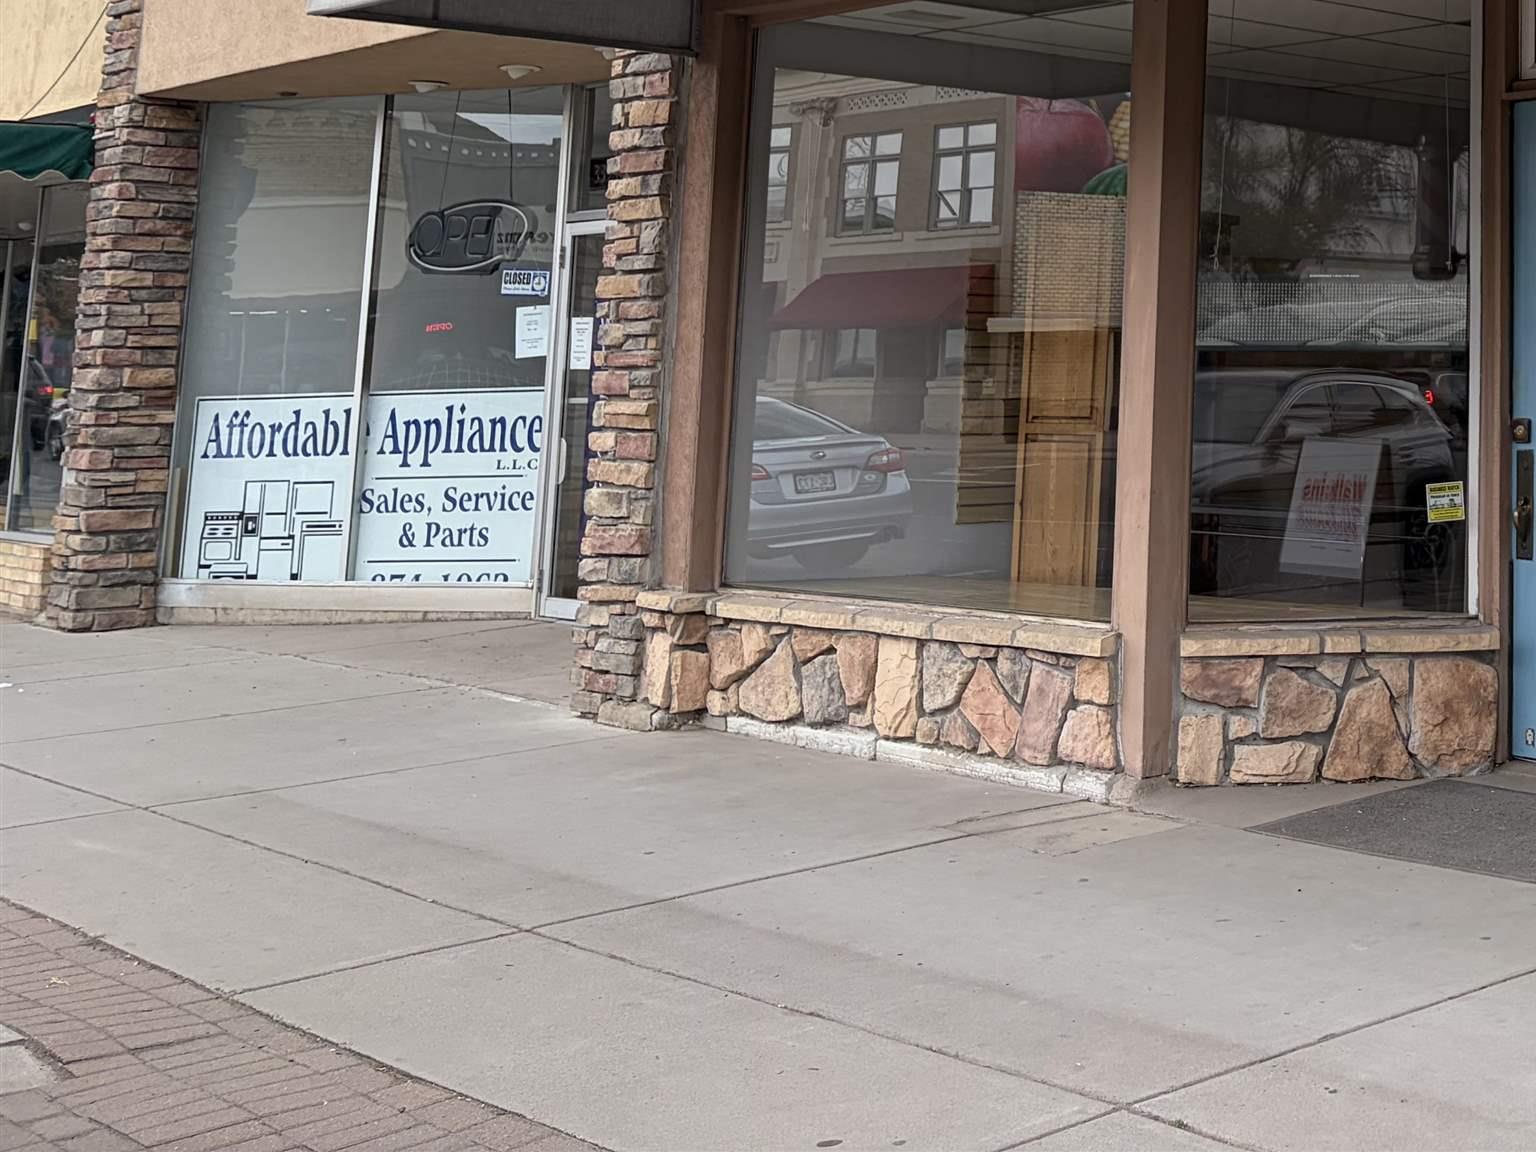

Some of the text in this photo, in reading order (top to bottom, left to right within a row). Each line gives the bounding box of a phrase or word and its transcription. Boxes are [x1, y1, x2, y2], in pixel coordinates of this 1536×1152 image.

[503, 272, 532, 285] CLOSED
[200, 403, 543, 468] Affordabl Appliance
[359, 484, 534, 517] Sales, Service
[398, 521, 489, 548] & Parts
